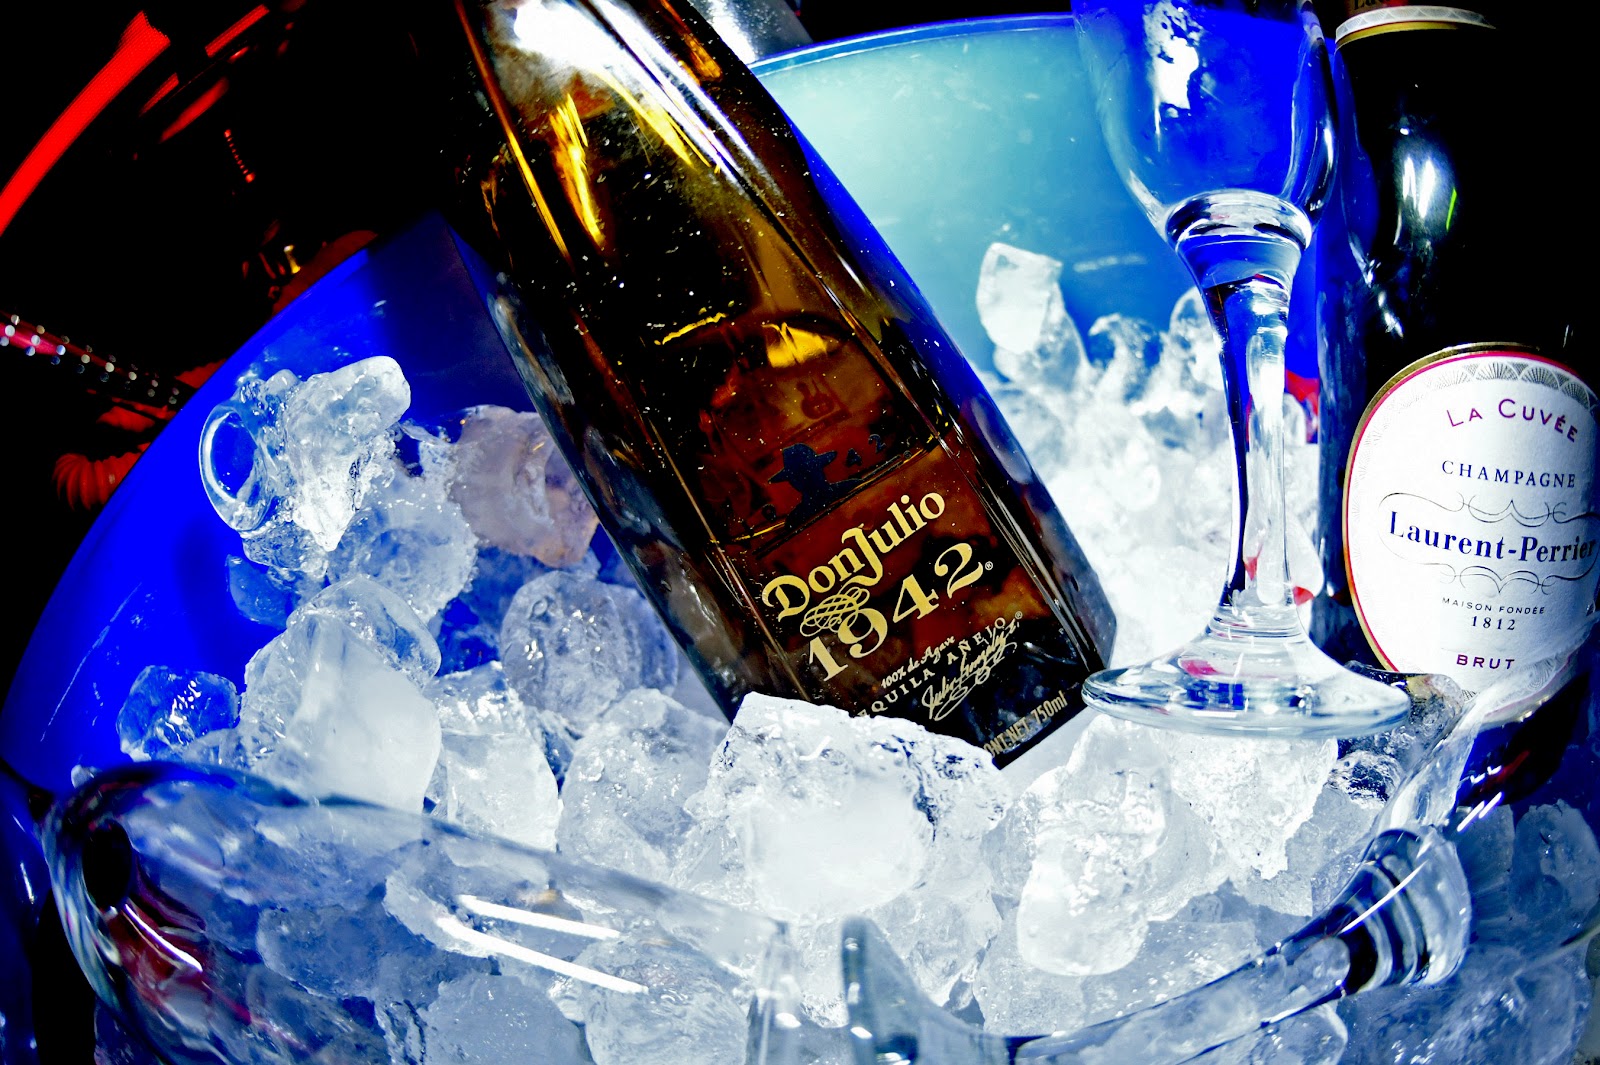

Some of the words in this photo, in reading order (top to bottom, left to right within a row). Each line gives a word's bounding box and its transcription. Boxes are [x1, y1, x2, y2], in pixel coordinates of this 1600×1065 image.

[1446, 407, 1483, 427] LA
[1498, 398, 1578, 442] CUVÉE
[1441, 460, 1577, 488] CHAMPAGNE
[1389, 511, 1597, 563] Laurent-Perrier
[1441, 597, 1493, 612] MAISON
[1498, 605, 1545, 615] FONDÉE
[1471, 615, 1516, 631] 1812
[857, 668, 935, 717] EQUILA
[946, 617, 1006, 665] AÑEJO
[881, 666, 907, 689] 100%
[907, 657, 921, 673] de
[921, 636, 956, 664] Agave
[1456, 654, 1515, 670] BRUT
[1030, 690, 1068, 725] 750ml
